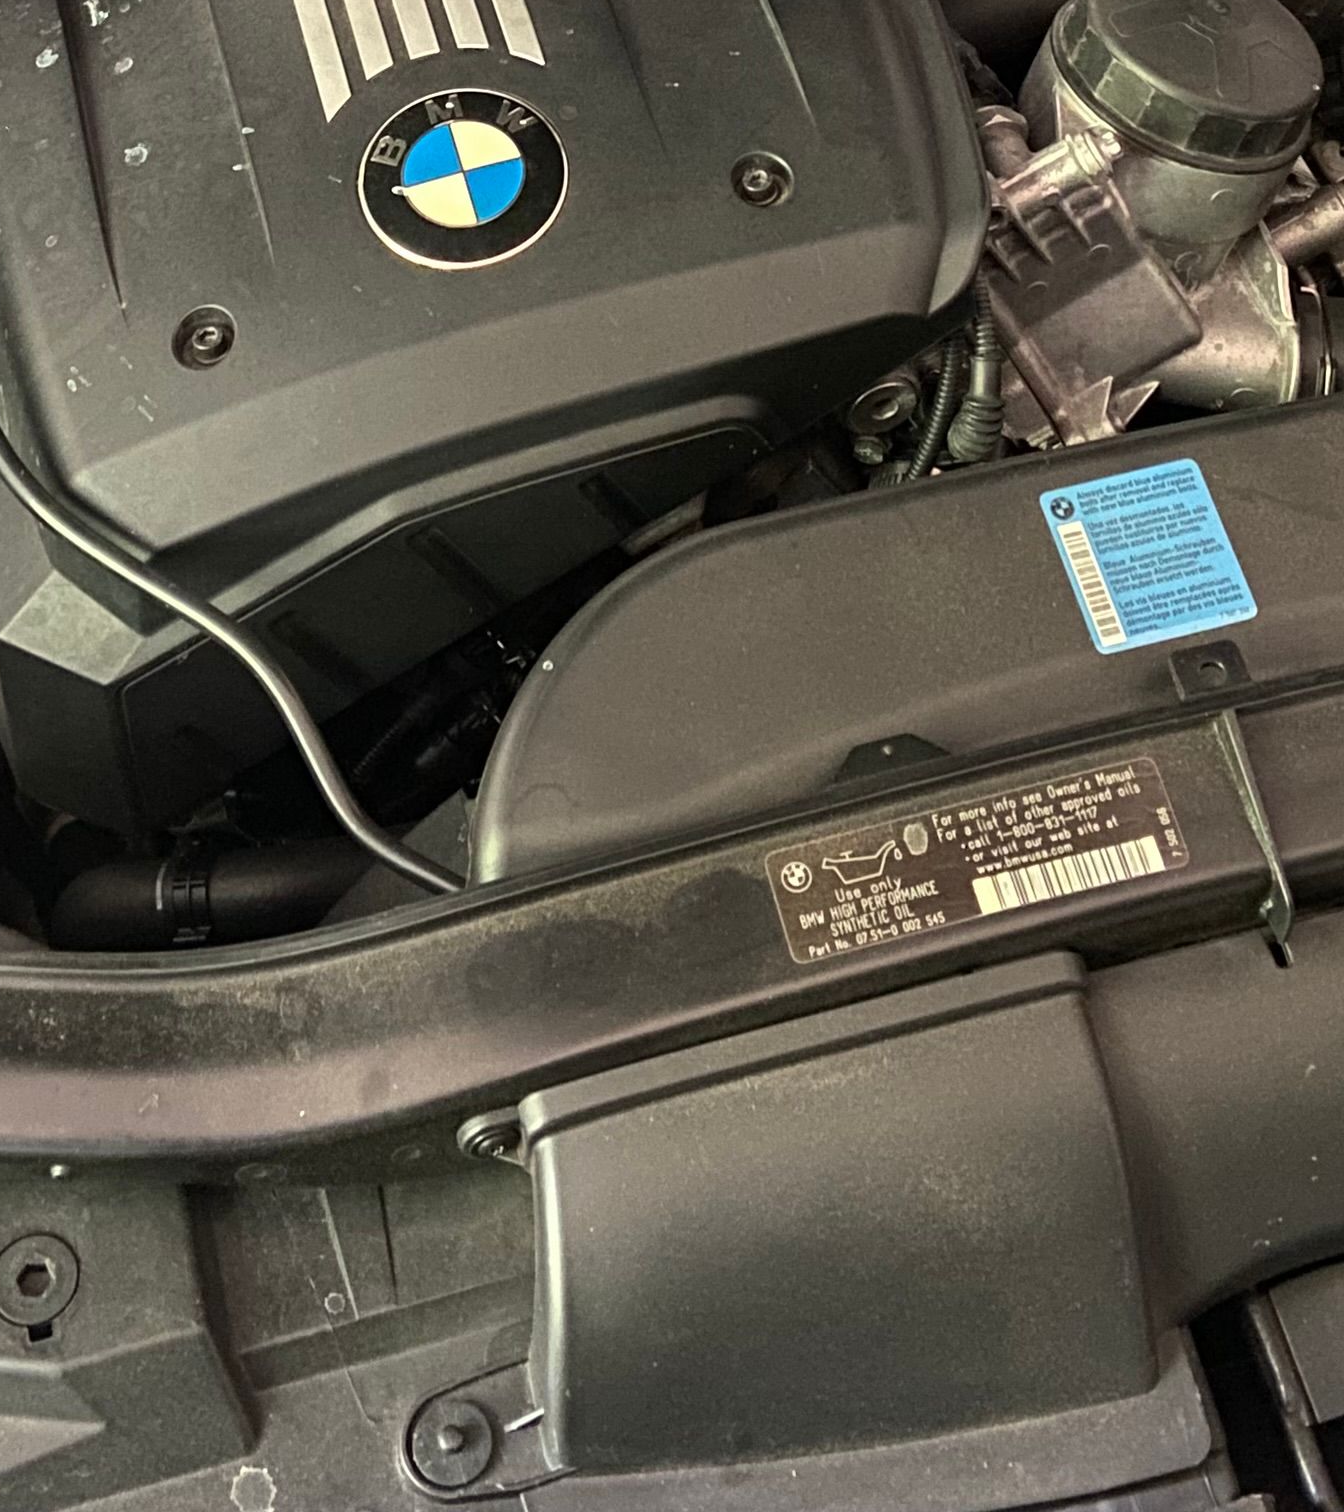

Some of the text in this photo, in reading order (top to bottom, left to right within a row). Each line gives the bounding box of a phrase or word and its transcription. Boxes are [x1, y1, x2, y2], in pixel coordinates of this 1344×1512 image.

[370, 94, 538, 167] BMW
[931, 765, 1135, 828] For more info see Owner's Manual
[936, 781, 1140, 843] For a list of other approved oils
[990, 840, 1018, 856] visit
[1024, 836, 1041, 848] our
[1049, 827, 1071, 841] web
[1076, 821, 1100, 835] site
[1105, 814, 1118, 828] at
[996, 805, 1097, 840] 1-800-831-1117
[976, 843, 1072, 873] www.bmwusa.com
[799, 880, 938, 929] BMW HIGH PERFORMANCE
[834, 875, 901, 902] Use only
[808, 942, 830, 958] Part
[834, 939, 851, 950] No.
[902, 917, 921, 932] 002
[925, 910, 945, 926] 545
[830, 904, 915, 936] SYNTHETIC OIL
